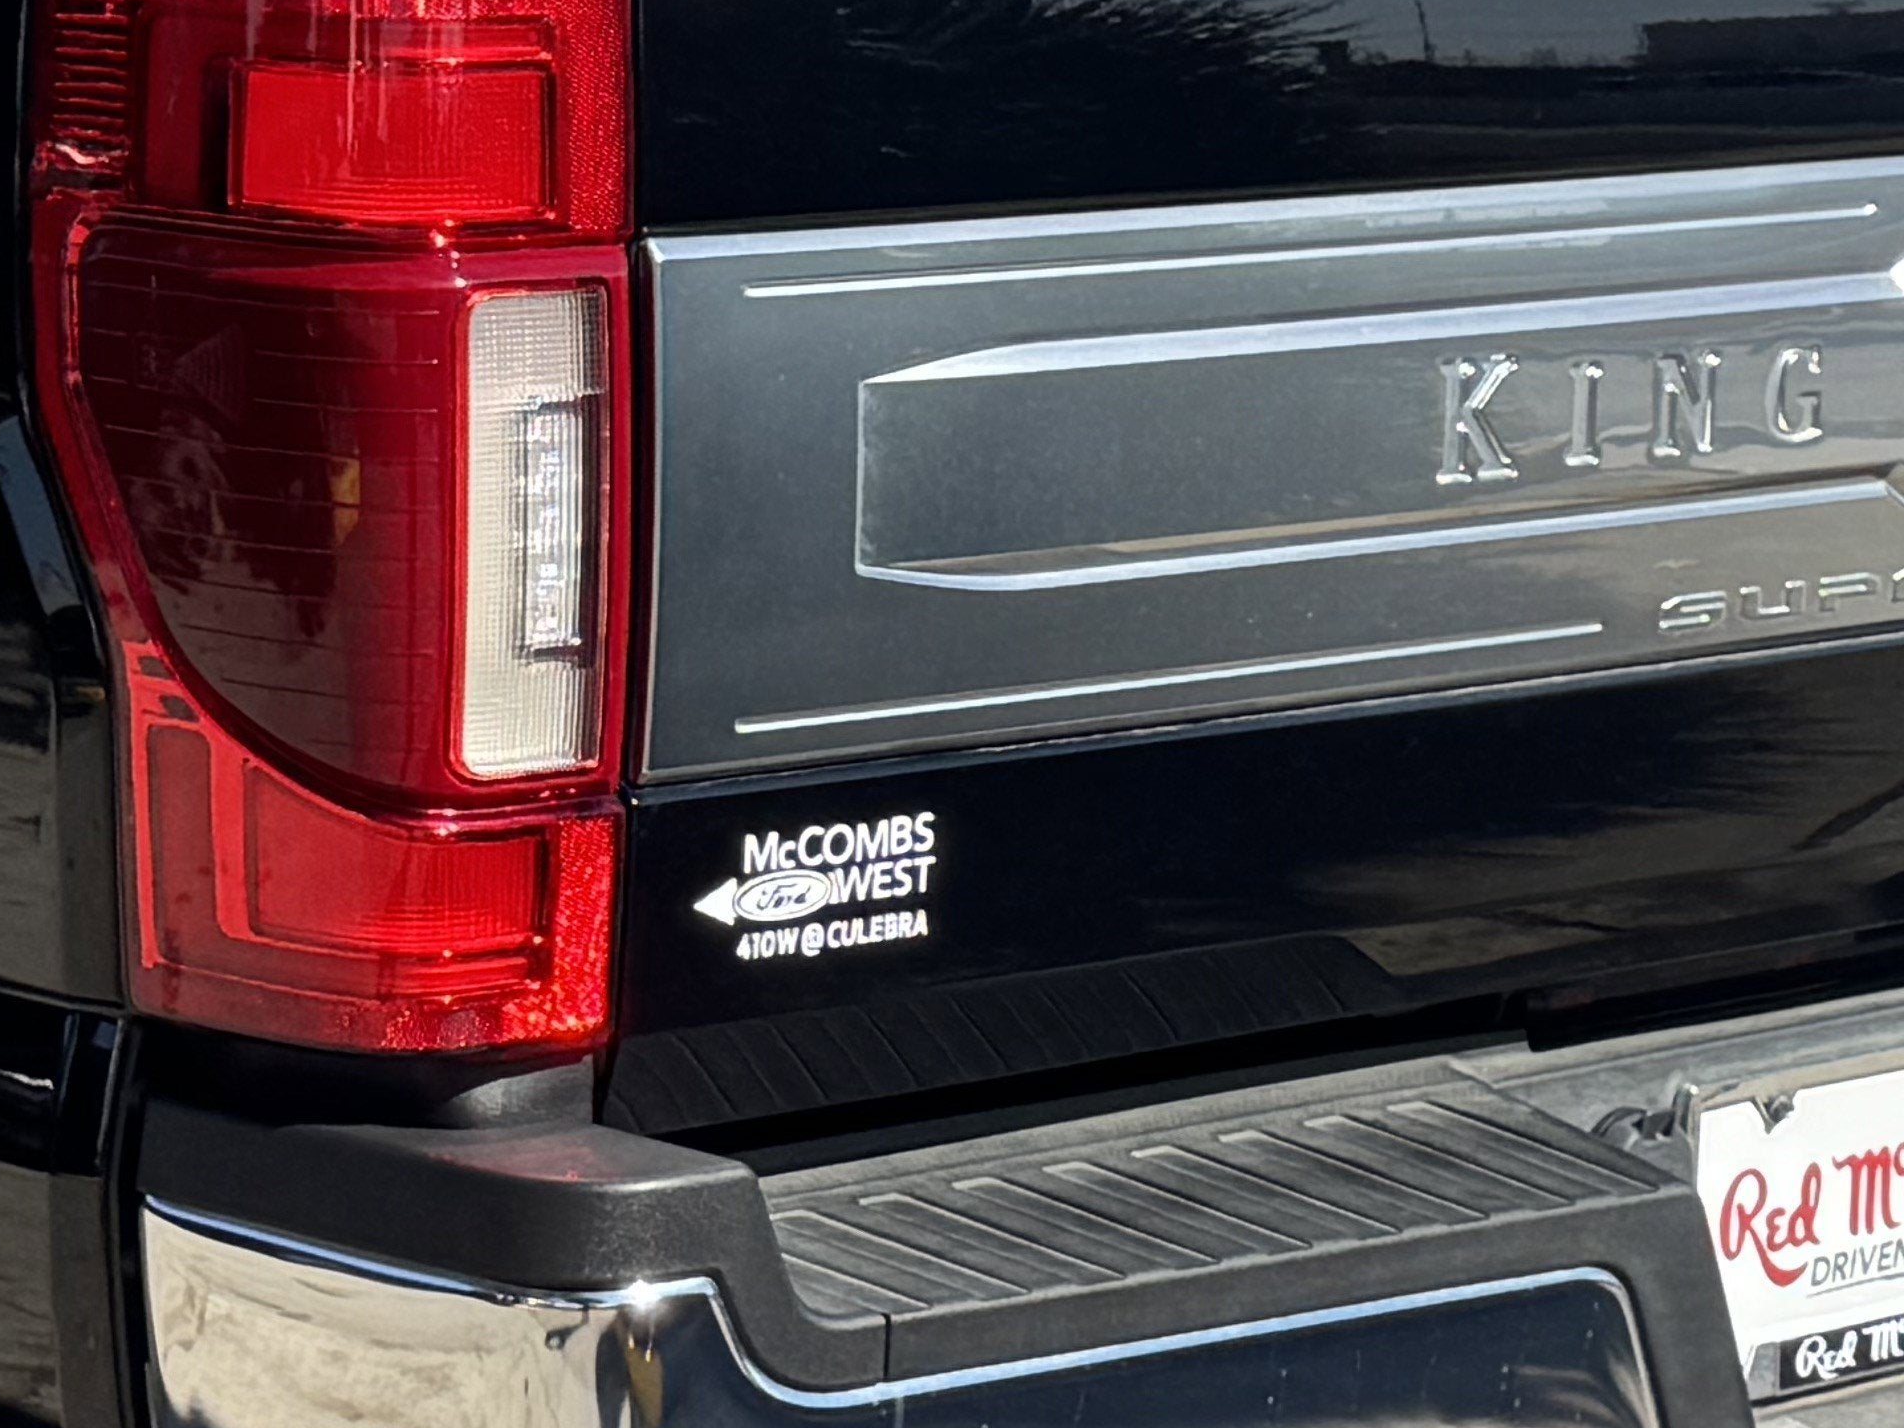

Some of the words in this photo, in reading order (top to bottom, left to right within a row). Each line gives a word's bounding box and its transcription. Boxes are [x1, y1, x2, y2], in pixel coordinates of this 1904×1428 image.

[1433, 346, 1826, 487] KING
[743, 810, 936, 875] McCOMBS
[755, 883, 813, 912] Ford
[827, 855, 938, 905] WEST
[1719, 1162, 1822, 1287] Red
[1795, 1333, 1857, 1380] Red
